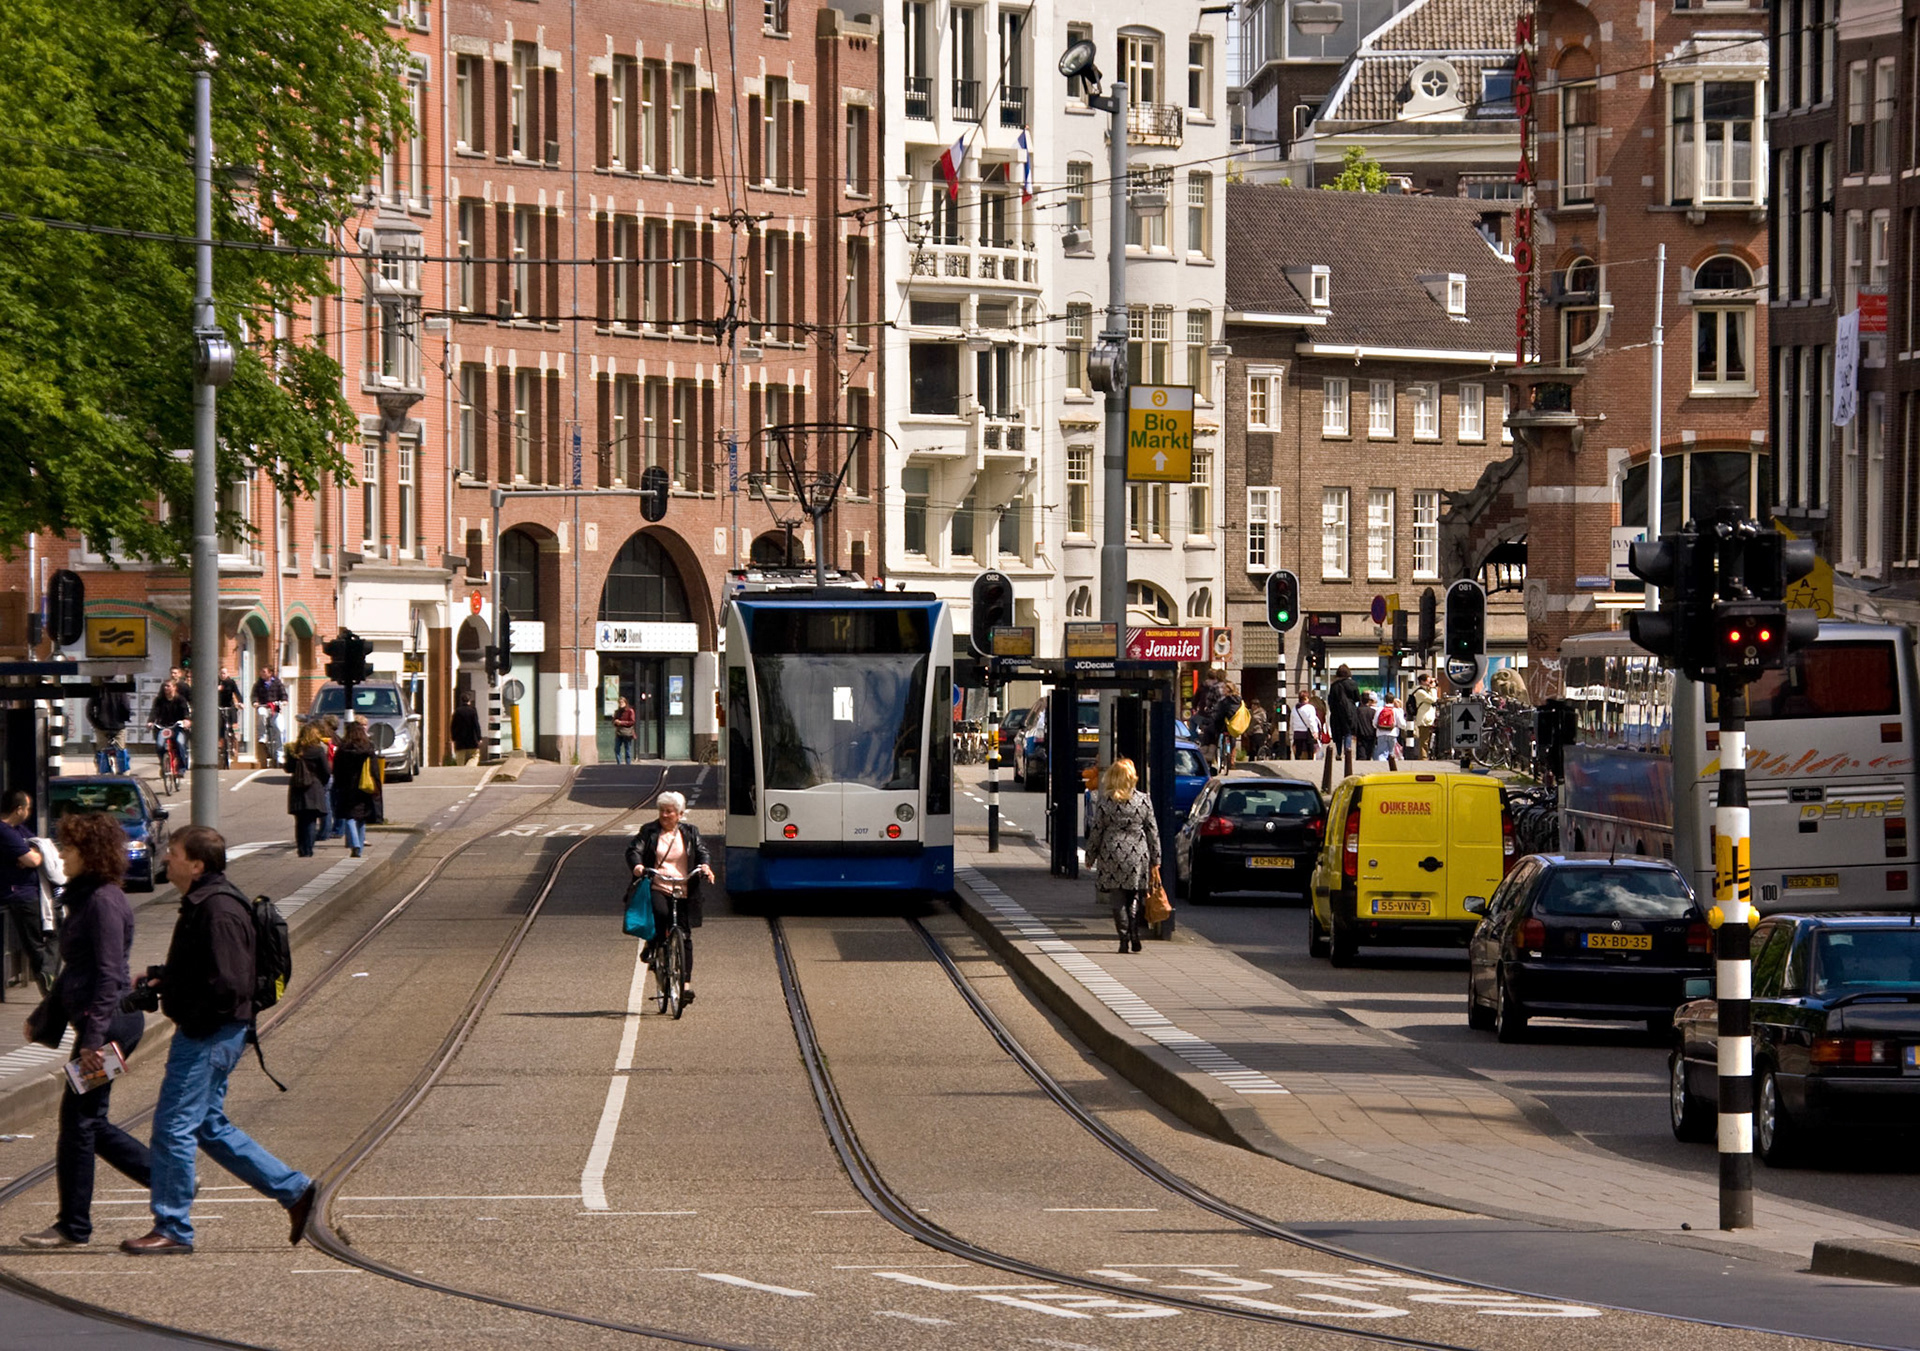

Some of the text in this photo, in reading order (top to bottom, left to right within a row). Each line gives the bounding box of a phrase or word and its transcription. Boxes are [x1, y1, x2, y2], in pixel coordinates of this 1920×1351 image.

[1514, 13, 1532, 368] NADIA HOTEL
[1145, 413, 1177, 431] Bio
[1131, 430, 1189, 449] Markt
[1800, 579, 1810, 588] A
[614, 628, 642, 643] DHB Bank
[830, 615, 851, 640] 17
[1145, 640, 1200, 657] Jennifer
[1074, 661, 1115, 669] JCDecaux
[1408, 802, 1431, 811] BAAS
[1800, 797, 1905, 821] DÉTRÉ
[1761, 885, 1778, 901] 100
[1381, 901, 1427, 911] 55-VNV-3
[1591, 935, 1648, 948] SX-BD-35
[975, 1291, 1602, 1319] BUS
